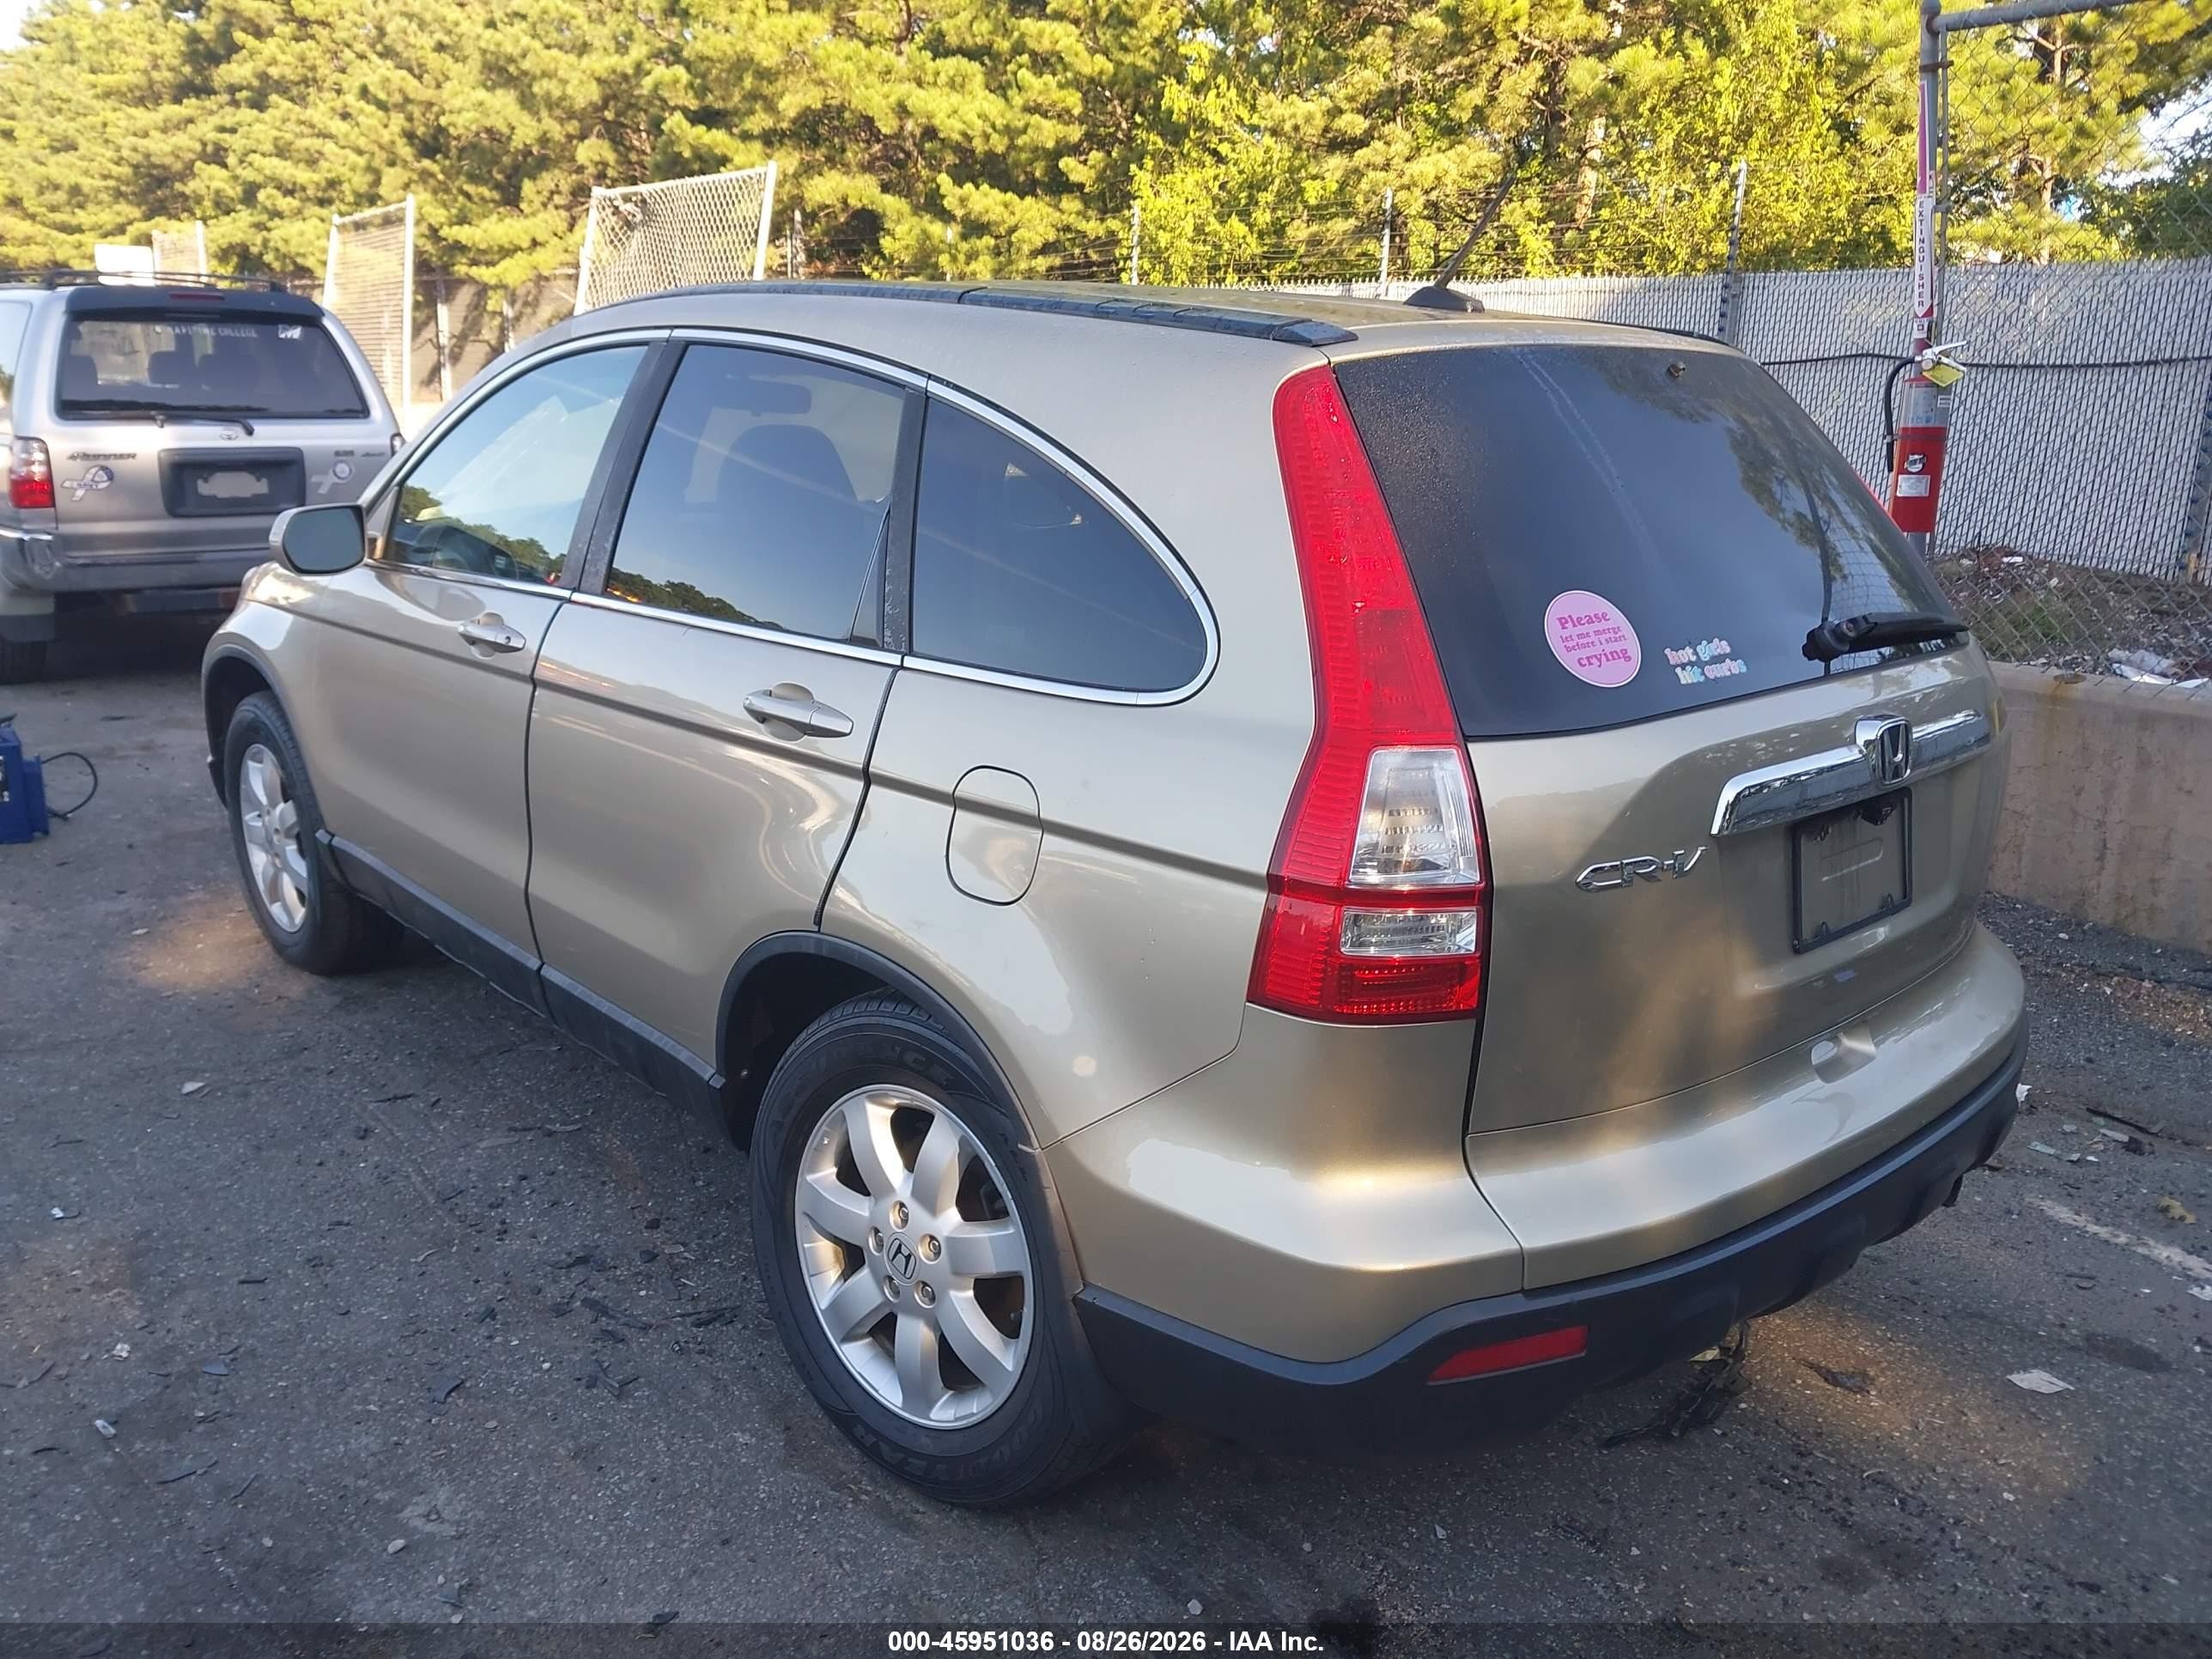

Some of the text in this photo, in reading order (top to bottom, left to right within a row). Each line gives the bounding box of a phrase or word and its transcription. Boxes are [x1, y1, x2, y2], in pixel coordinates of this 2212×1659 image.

[1557, 611, 1610, 629] Please
[1559, 626, 1621, 643] let me merge
[1564, 641, 1596, 653] before
[1605, 635, 1627, 644] start
[1577, 648, 1632, 668] crying
[1664, 646, 1697, 665] hot
[1674, 665, 1705, 684] hit
[1575, 845, 1710, 893] CR-V
